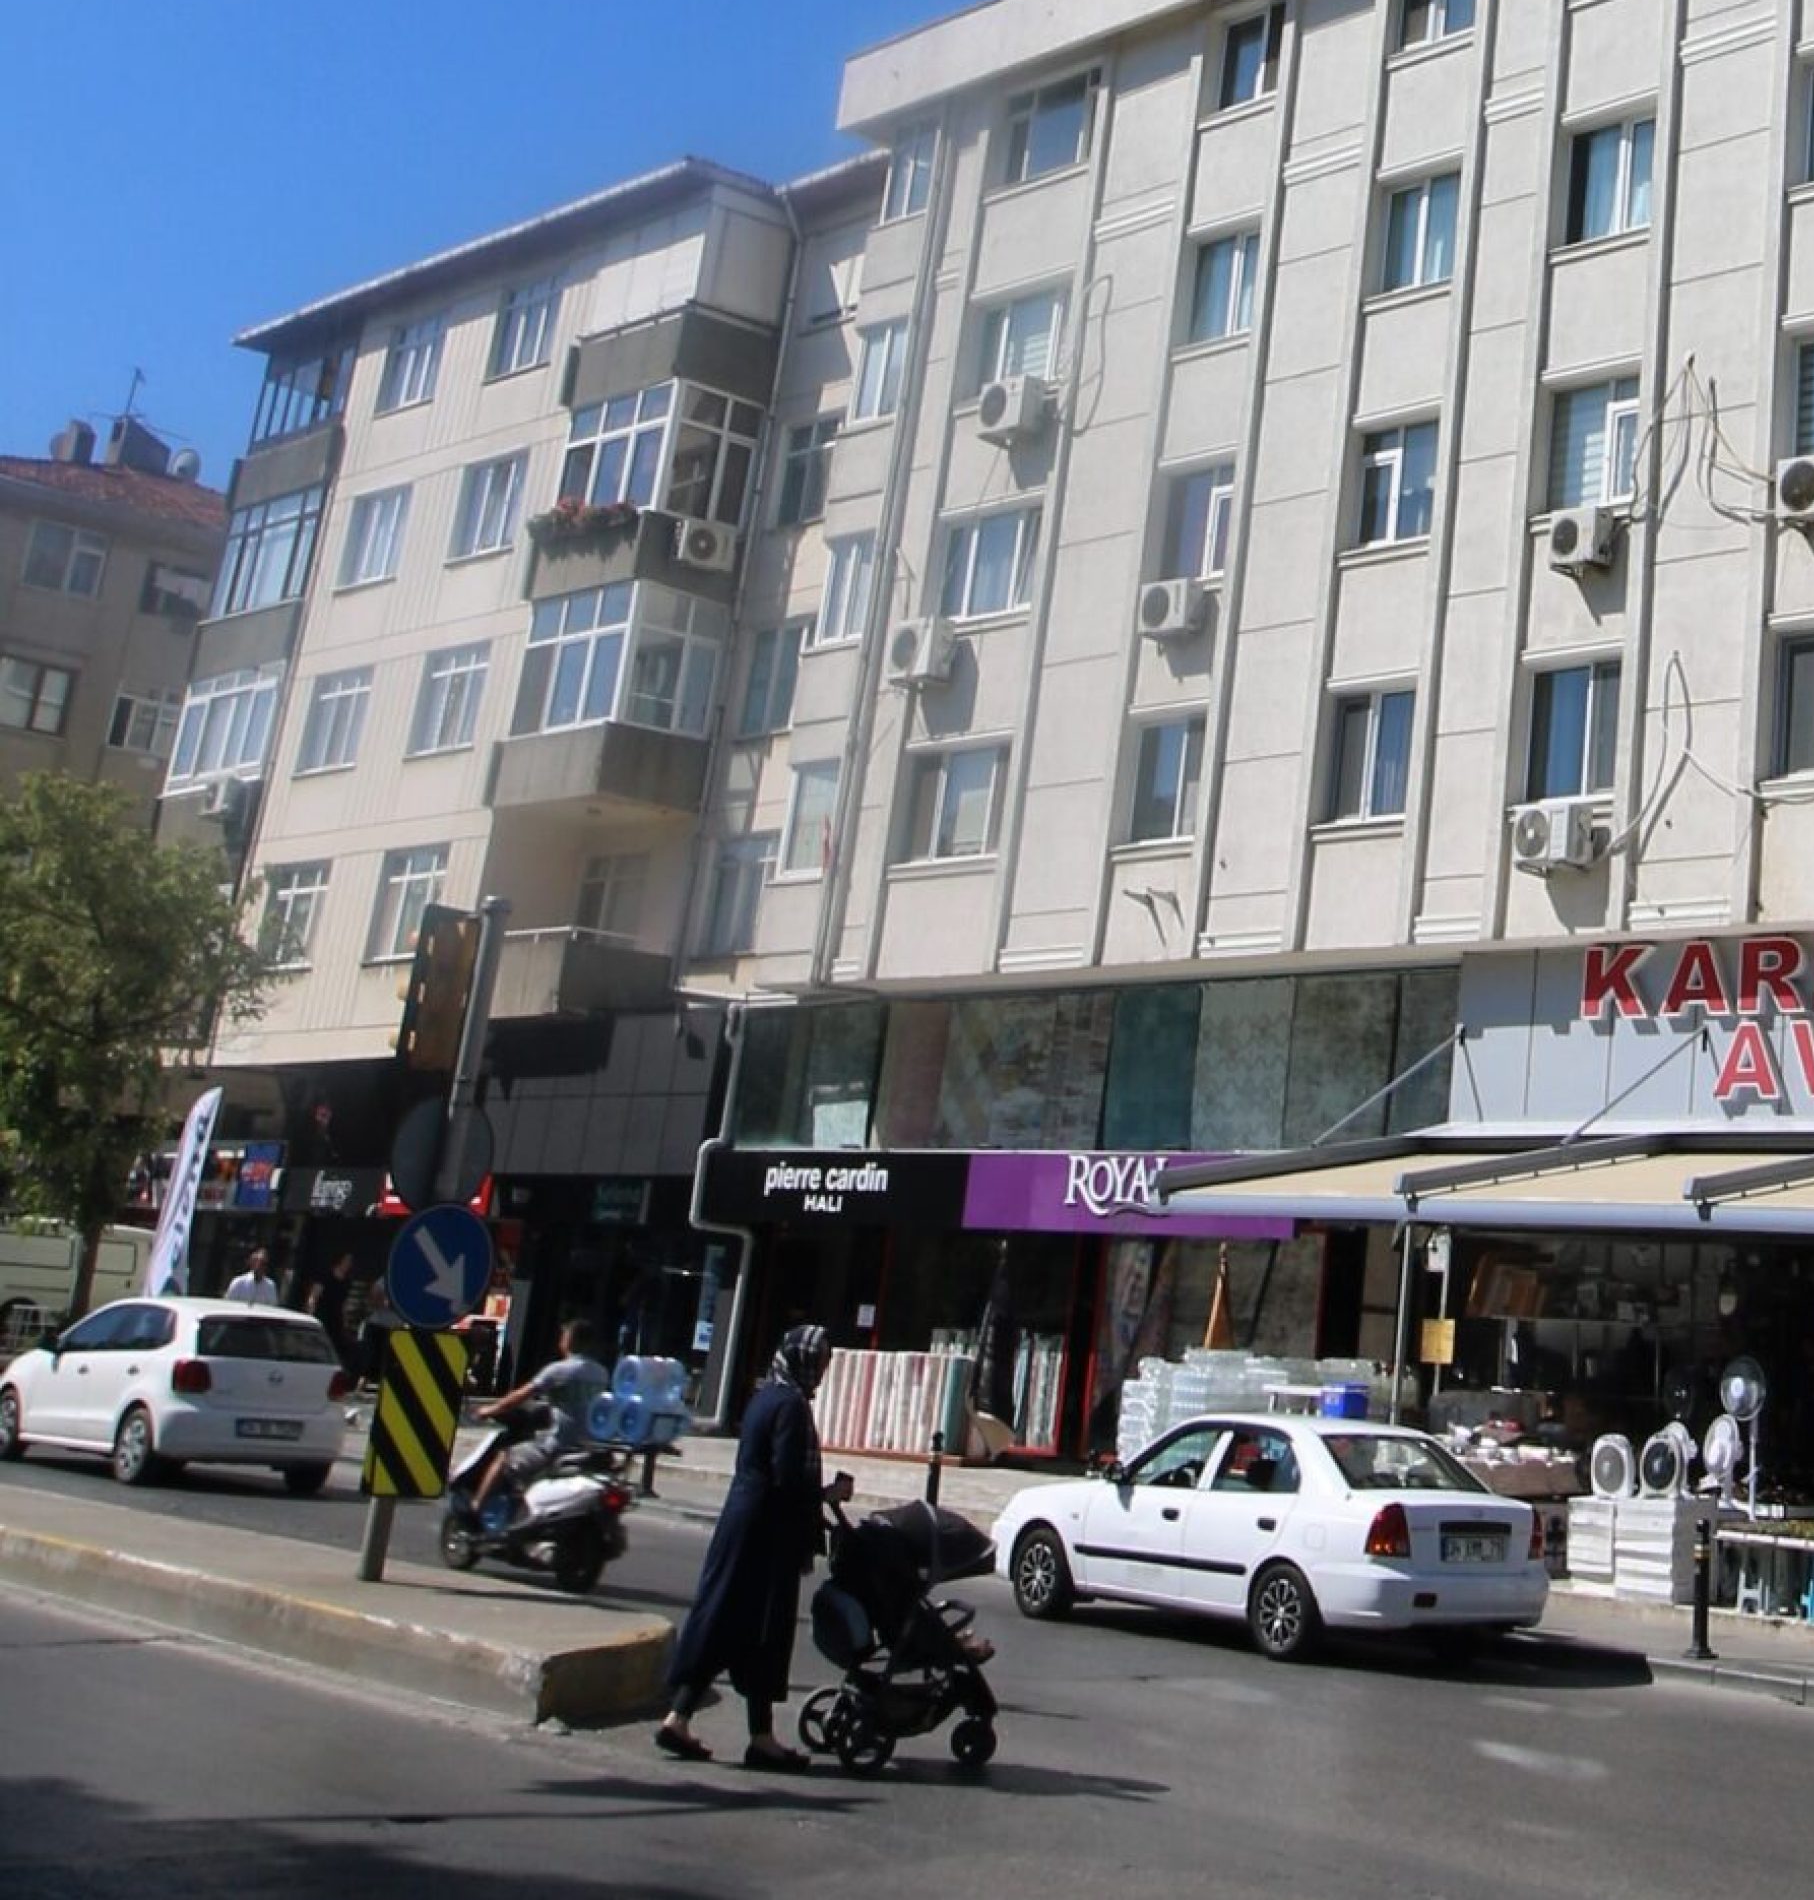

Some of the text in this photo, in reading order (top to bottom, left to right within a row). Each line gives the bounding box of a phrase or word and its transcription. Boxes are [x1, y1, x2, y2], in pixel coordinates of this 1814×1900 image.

[763, 1160, 889, 1197] pierre cardin
[1064, 1154, 1168, 1216] ROYA
[803, 1194, 844, 1212] HALI
